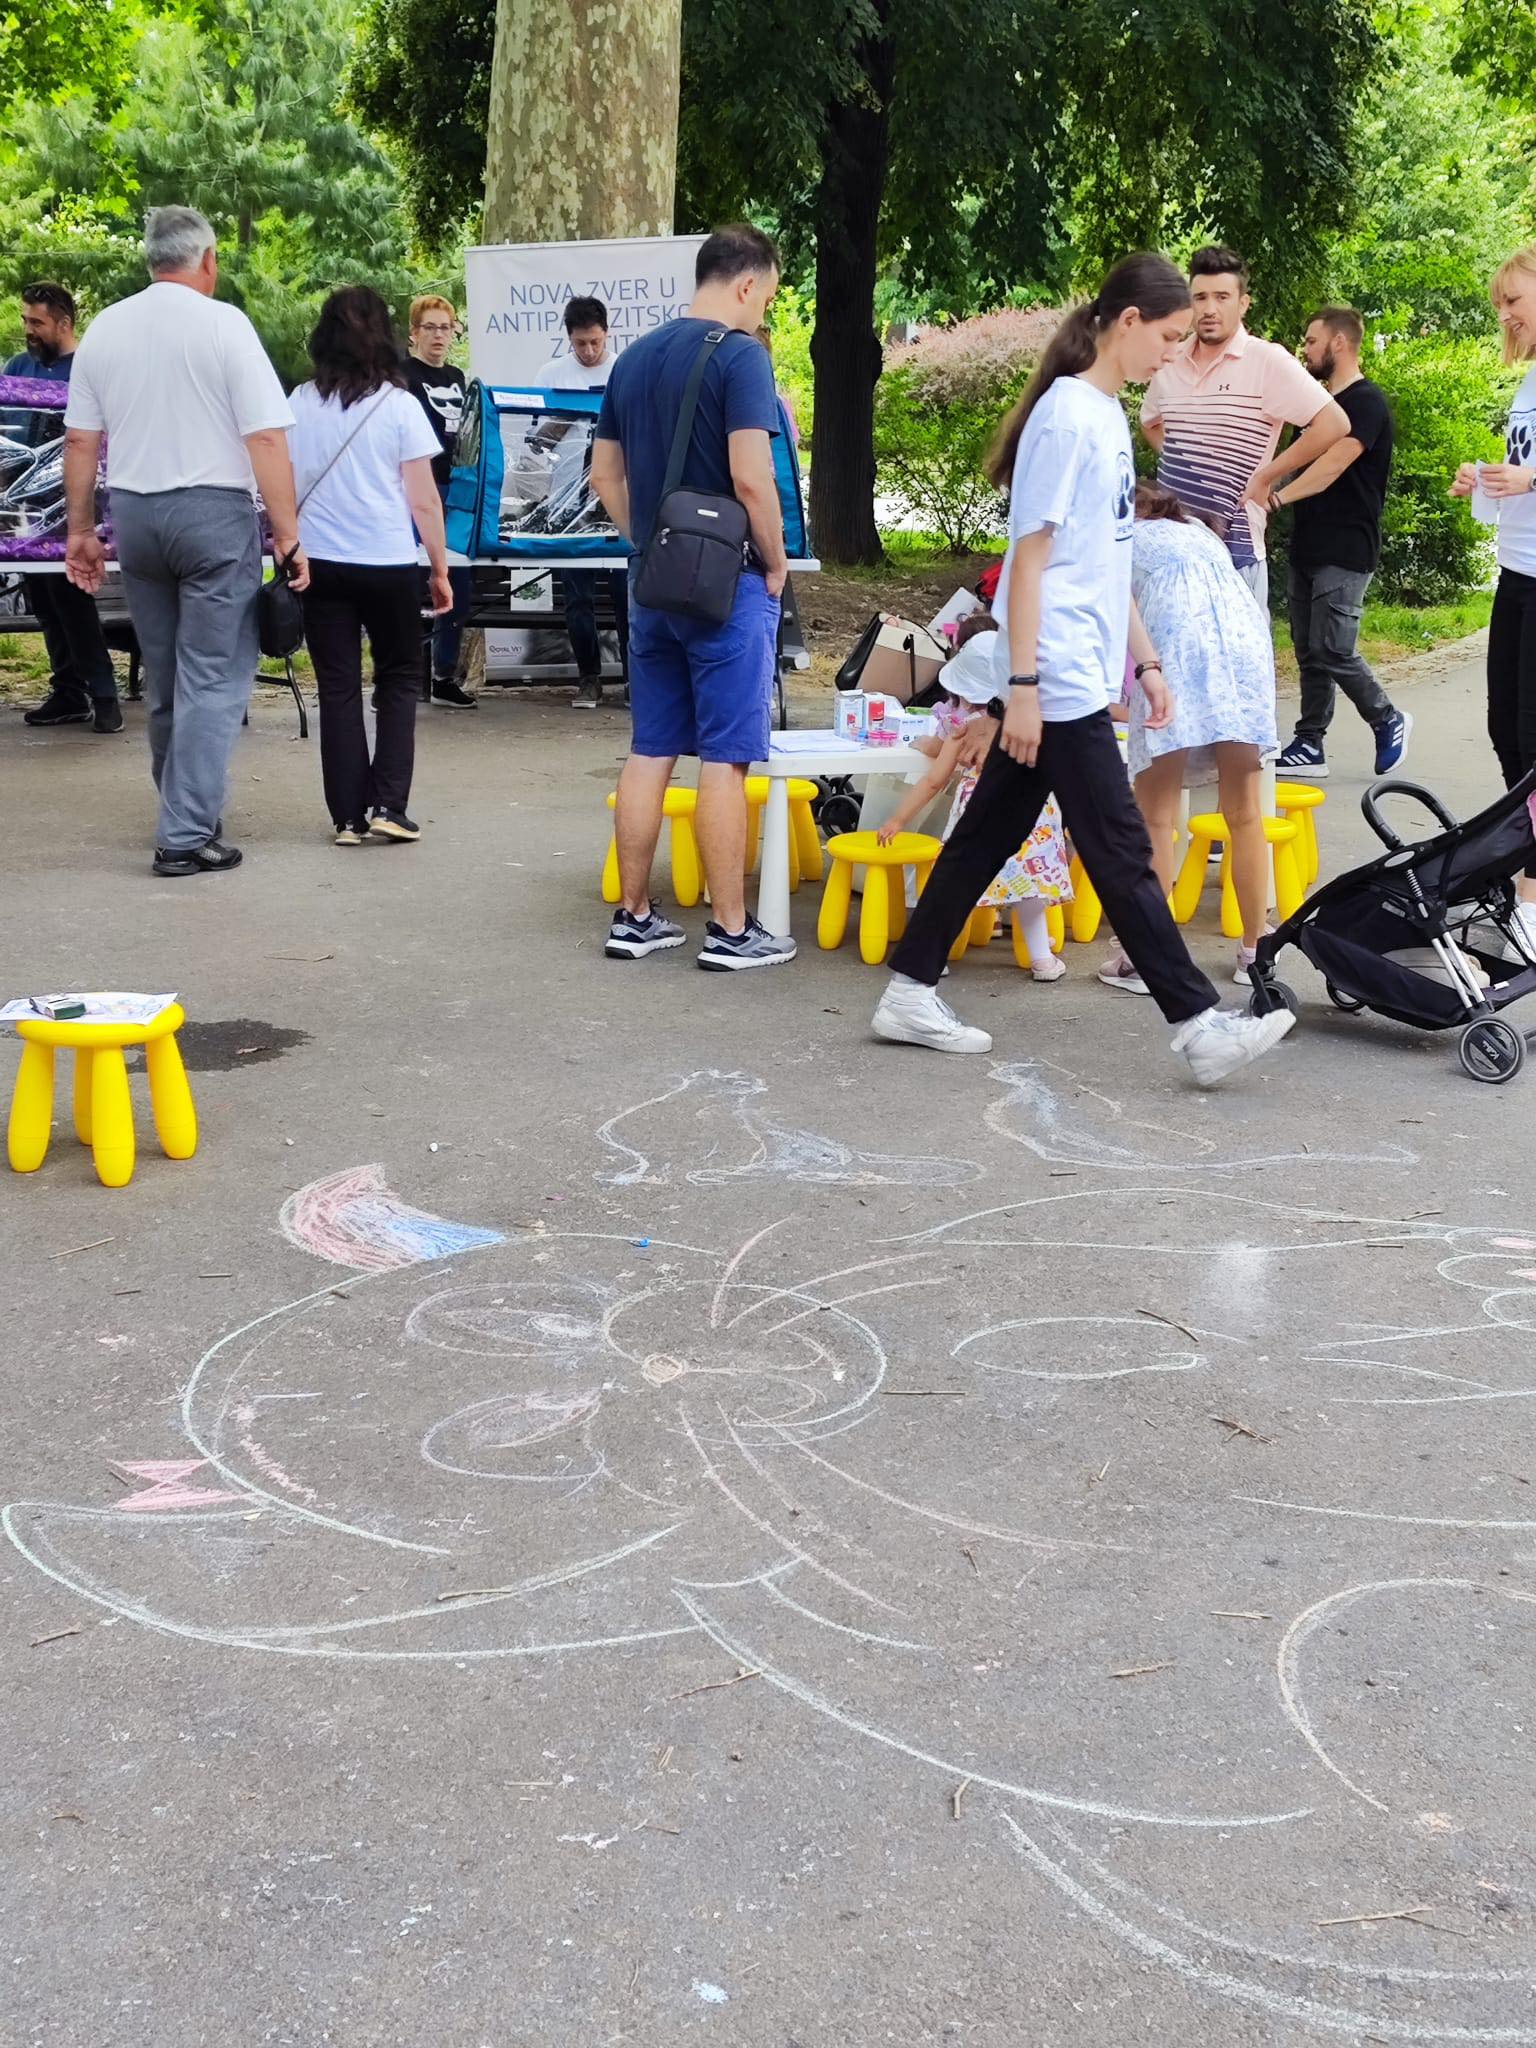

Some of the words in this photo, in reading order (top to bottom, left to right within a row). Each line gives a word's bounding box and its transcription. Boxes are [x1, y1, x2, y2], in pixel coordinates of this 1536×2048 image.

[510, 283, 574, 305] NOVA
[586, 279, 649, 301] ZVER
[659, 277, 675, 298] U
